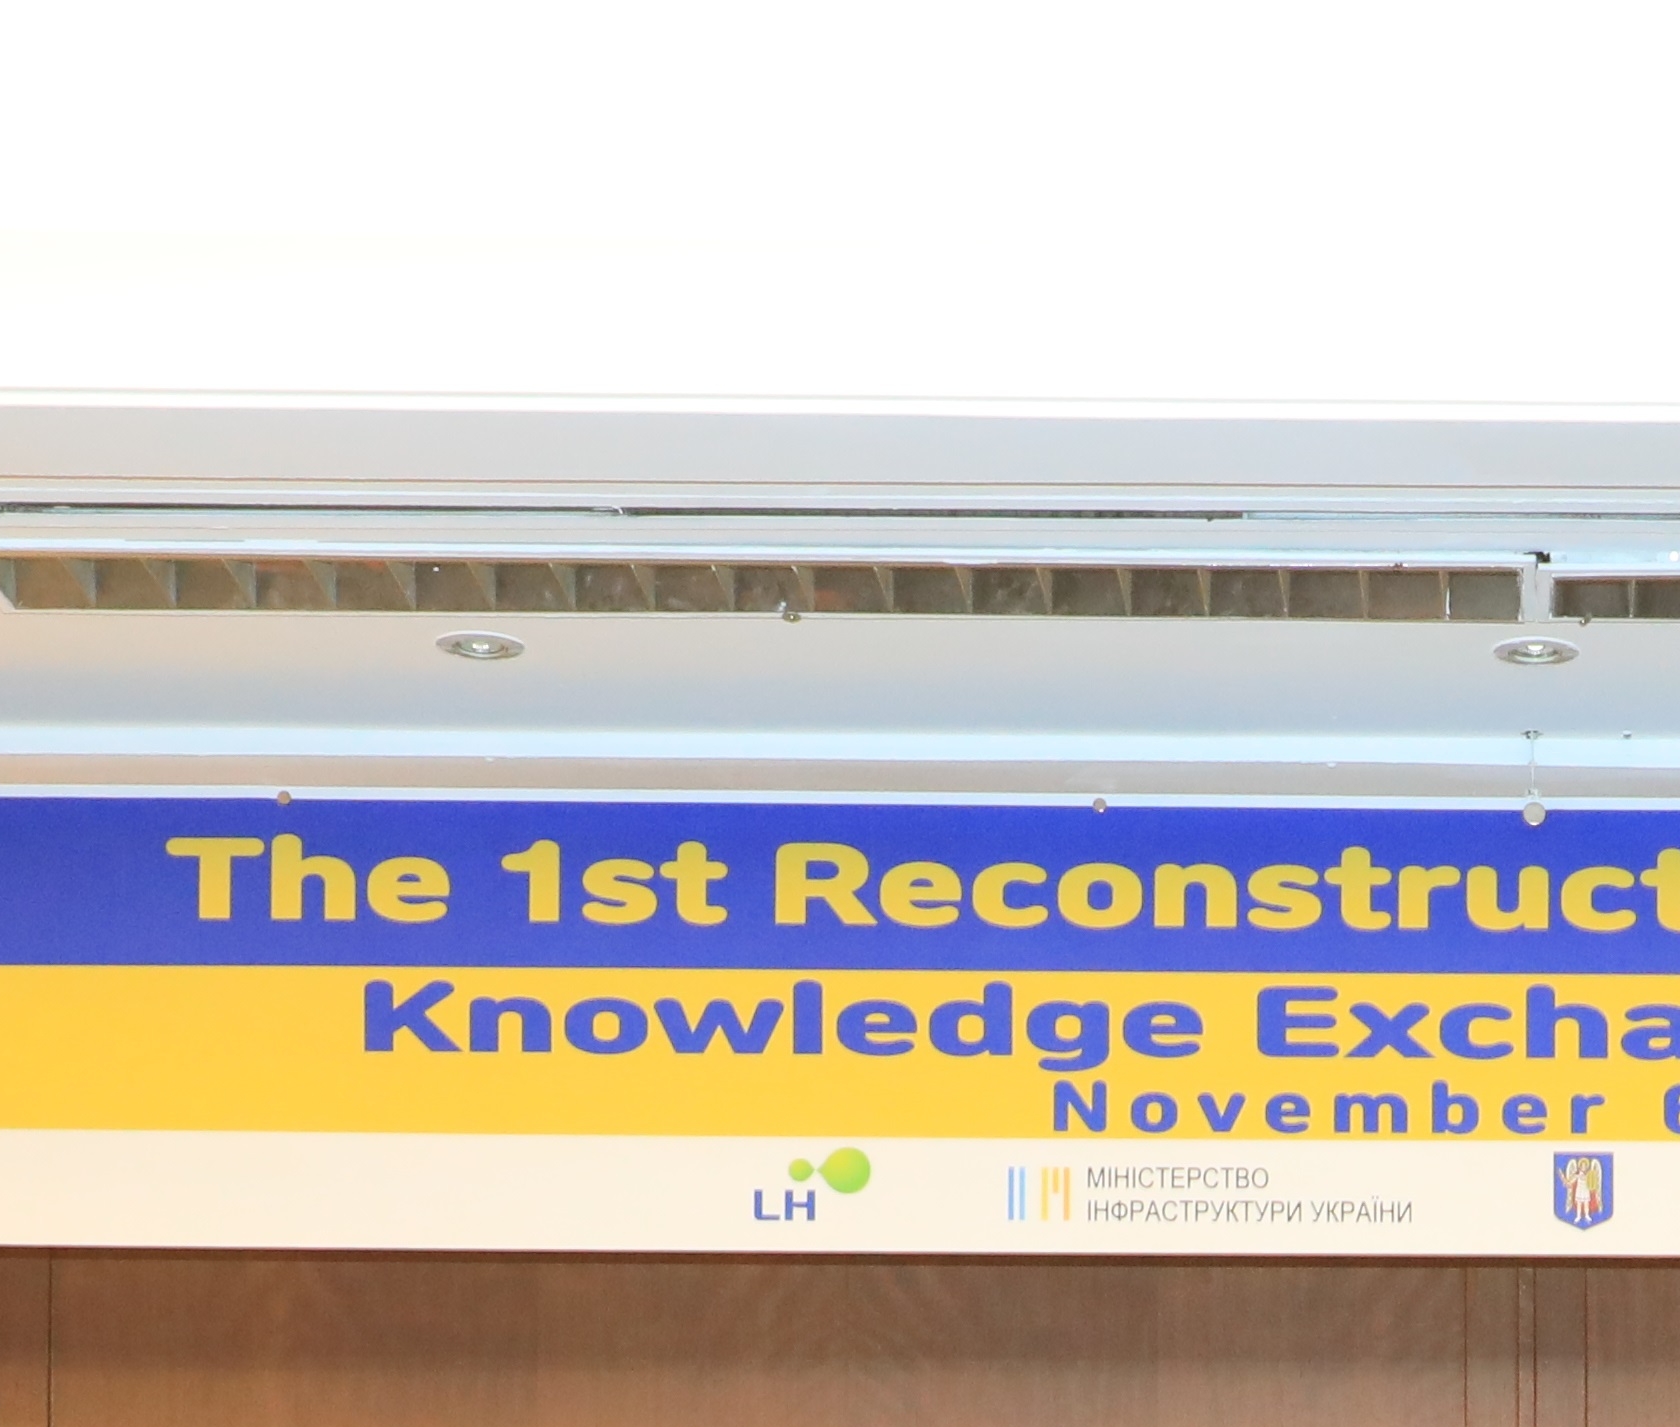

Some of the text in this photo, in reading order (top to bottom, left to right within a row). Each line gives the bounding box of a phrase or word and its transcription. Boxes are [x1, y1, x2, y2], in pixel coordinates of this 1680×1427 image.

[166, 833, 451, 923] The
[501, 839, 729, 926] 1st
[365, 981, 1203, 1072] Knowledge
[1053, 1080, 1605, 1135] November
[1086, 1166, 1270, 1190] МІНІСТЕРСТВО
[753, 1189, 816, 1221] LH
[1086, 1197, 1413, 1223] ІНФРАСТРУКТУРИ УКРАЇНИ
